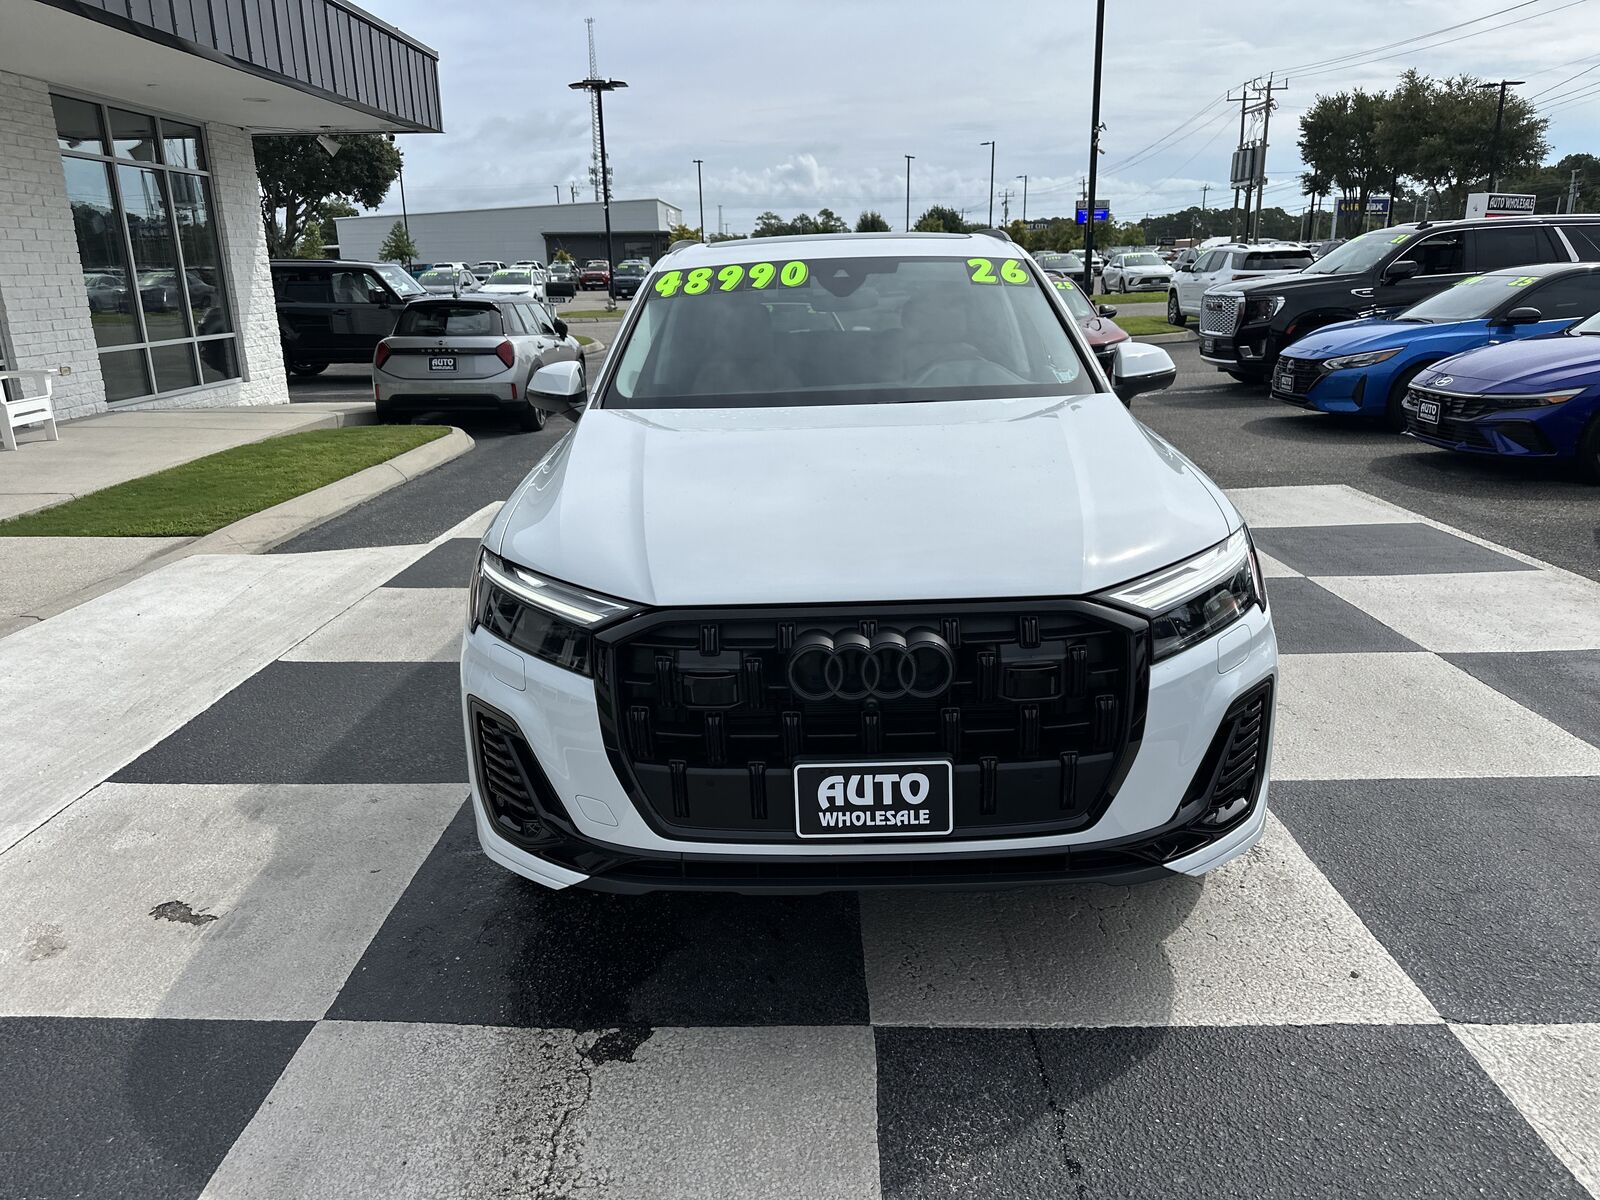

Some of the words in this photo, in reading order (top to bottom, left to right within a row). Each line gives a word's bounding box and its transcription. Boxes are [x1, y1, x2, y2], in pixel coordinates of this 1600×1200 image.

[1490, 197, 1505, 208] AUTO
[1506, 197, 1534, 210] WHOLESALE
[654, 260, 809, 298] 48990
[966, 257, 1029, 285] 26
[1054, 281, 1074, 290] 25
[432, 358, 454, 366] AUTO
[1420, 403, 1437, 415] AUTO
[817, 772, 930, 810] AUTO
[819, 809, 930, 828] WHOLESALE
